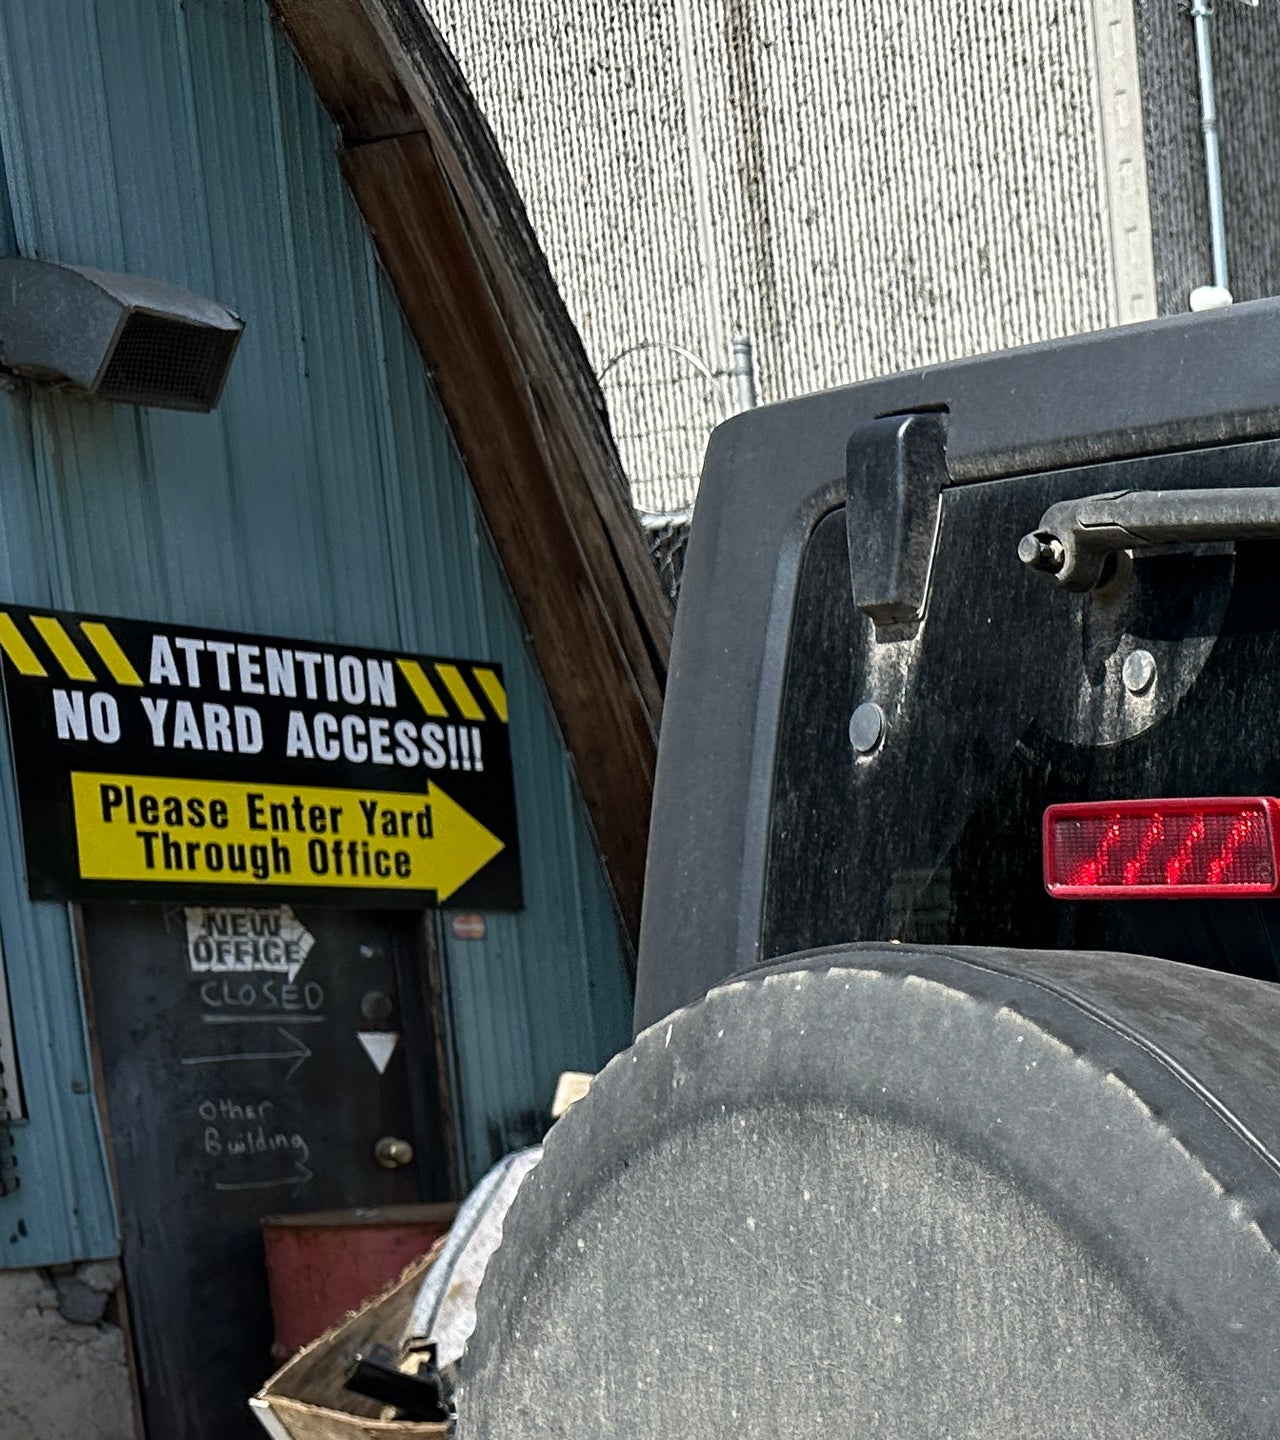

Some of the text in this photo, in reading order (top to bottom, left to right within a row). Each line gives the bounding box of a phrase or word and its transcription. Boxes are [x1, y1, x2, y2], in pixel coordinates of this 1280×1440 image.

[149, 634, 398, 708] ATTENTION
[52, 688, 485, 773] NO YARD ACCESS!!!
[99, 783, 434, 840] Please Enter Yard
[135, 830, 412, 881] Through Office
[206, 913, 281, 937] NEW
[193, 936, 301, 965] OFFICE
[200, 978, 325, 1011] CLOSED
[204, 1125, 310, 1164] Building
